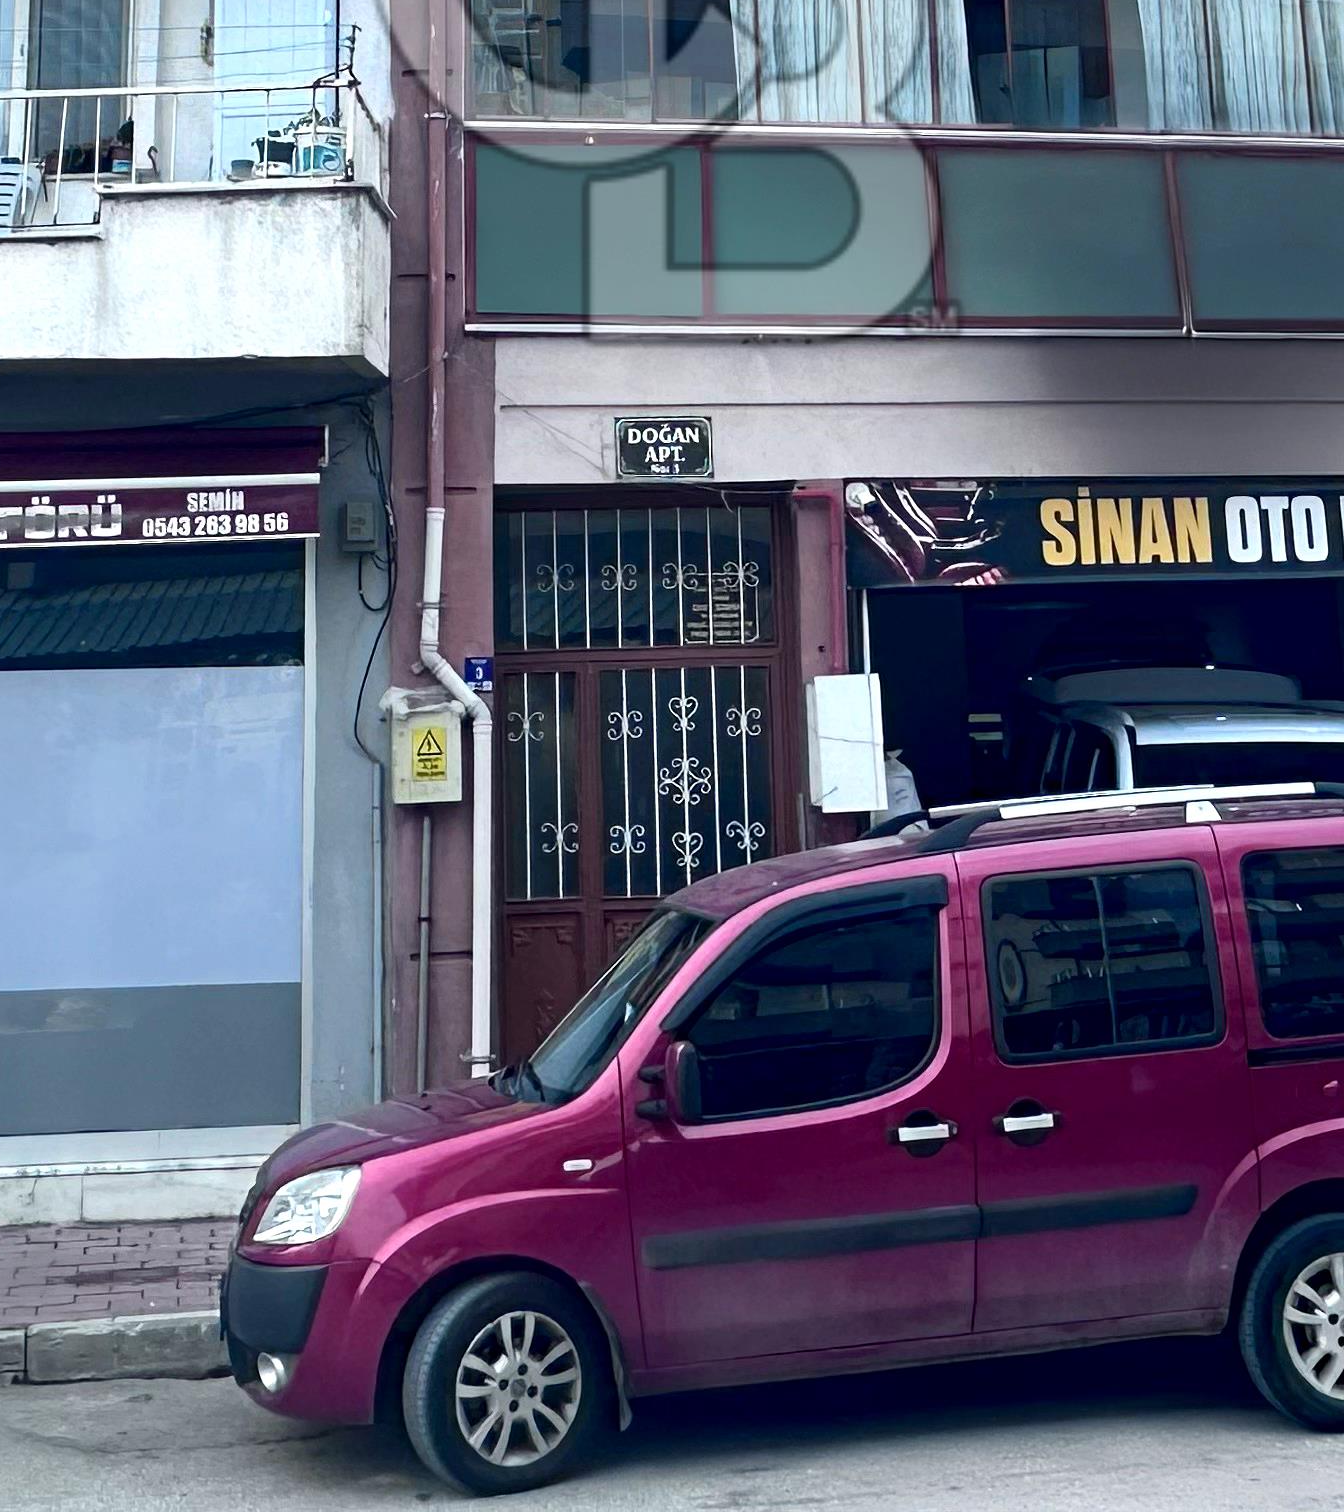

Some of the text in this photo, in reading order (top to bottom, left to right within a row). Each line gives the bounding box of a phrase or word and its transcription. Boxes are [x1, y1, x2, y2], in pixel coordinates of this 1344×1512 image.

[627, 423, 700, 444] DOĞAN
[644, 445, 686, 463] APT.
[186, 488, 245, 513] SEMİH
[142, 516, 191, 538] 0543
[262, 512, 290, 533] 56
[1039, 486, 1213, 567] SİNAN
[1224, 494, 1329, 564] OTO
